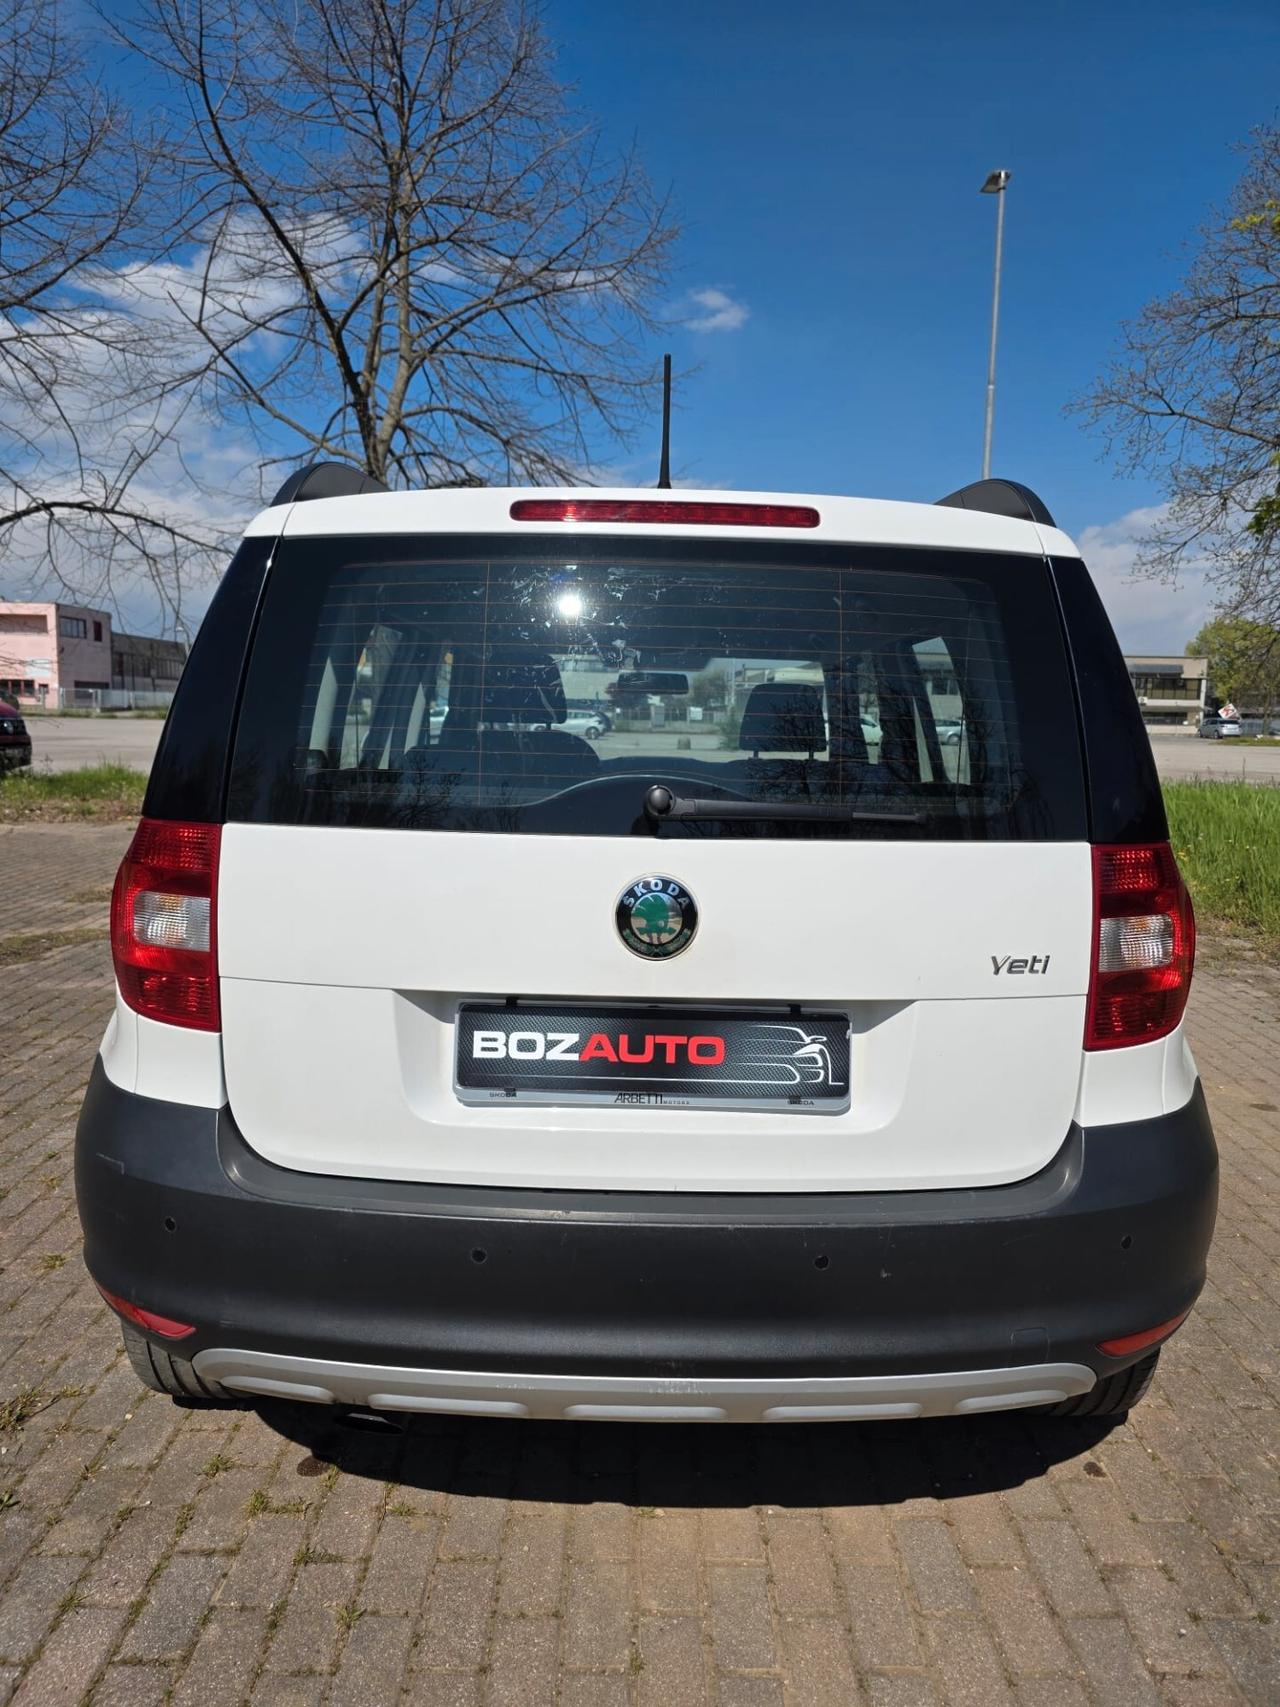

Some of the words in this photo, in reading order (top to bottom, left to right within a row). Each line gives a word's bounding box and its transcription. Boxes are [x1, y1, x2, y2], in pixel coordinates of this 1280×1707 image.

[991, 954, 1051, 976] Yeti
[472, 1030, 726, 1065] BOZAUTO
[614, 1092, 663, 1105] ARBETTI
